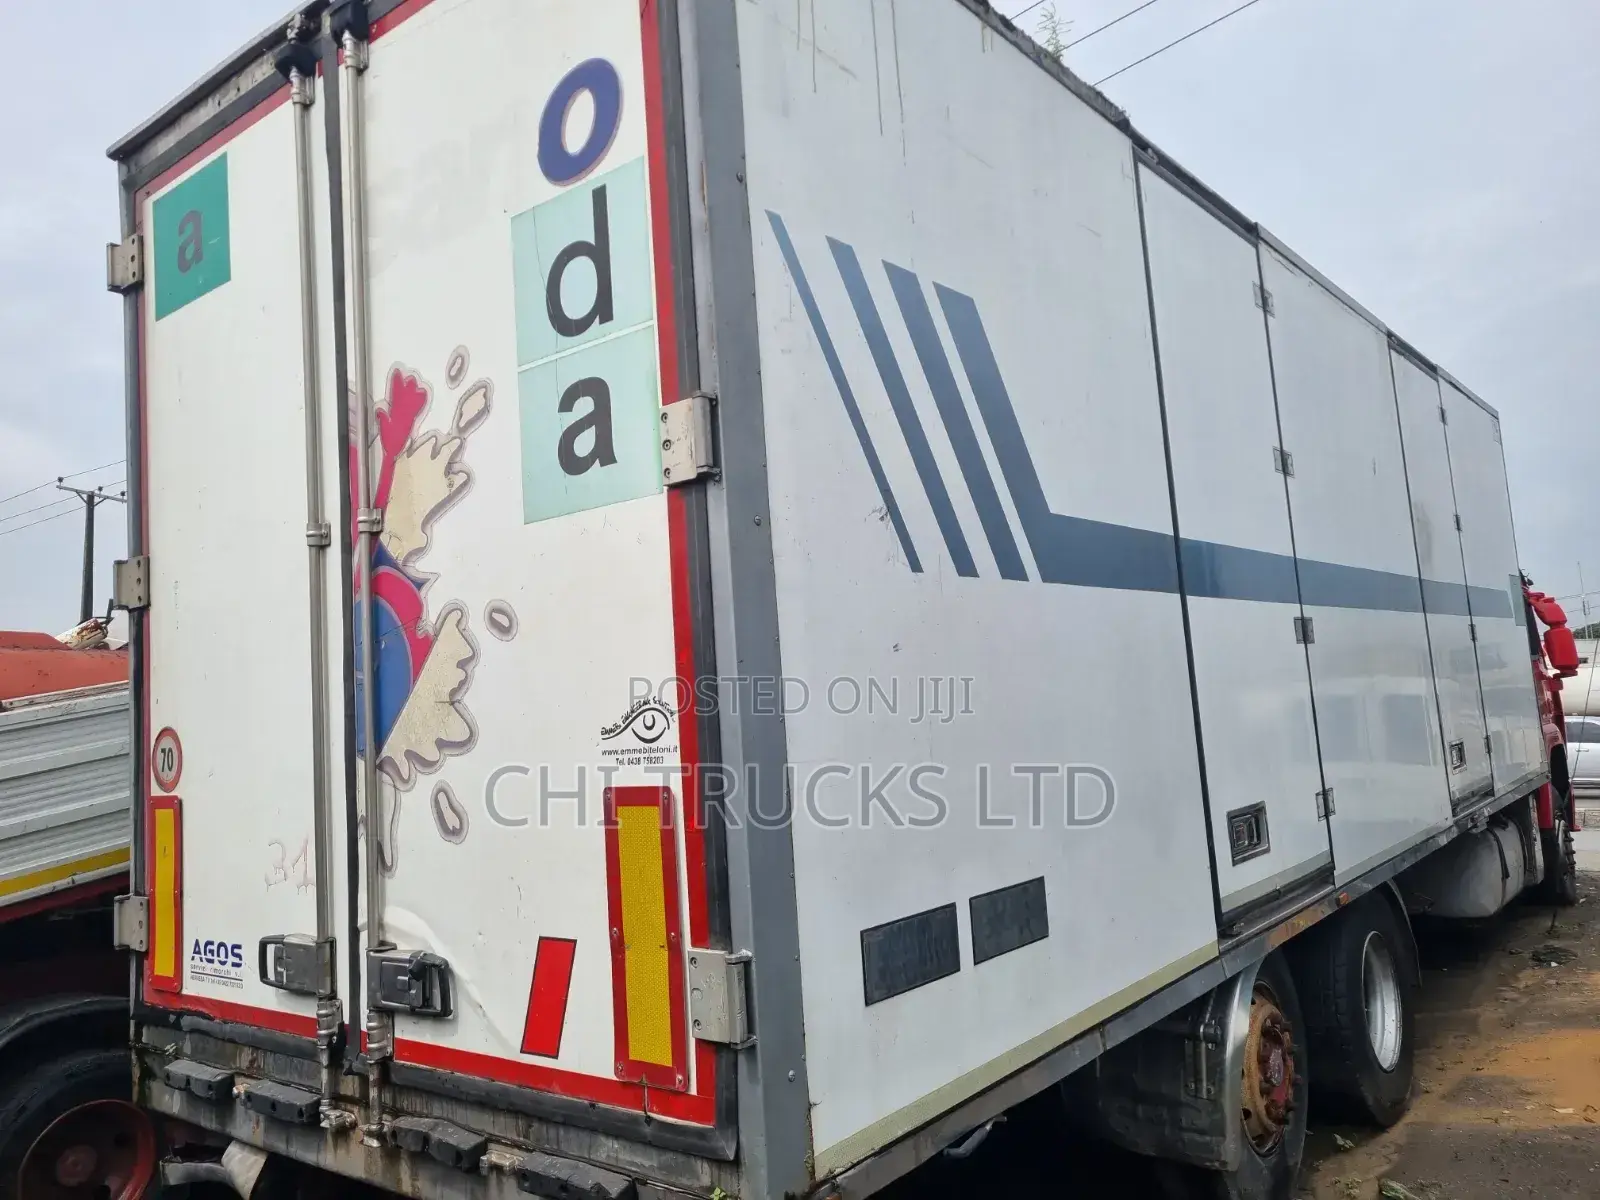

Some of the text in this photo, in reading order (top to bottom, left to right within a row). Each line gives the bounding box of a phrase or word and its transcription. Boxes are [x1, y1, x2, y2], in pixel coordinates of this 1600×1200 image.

[177, 210, 204, 275] a
[161, 747, 174, 773] 70
[616, 757, 625, 766] Tel.
[191, 938, 243, 968] AGOS
